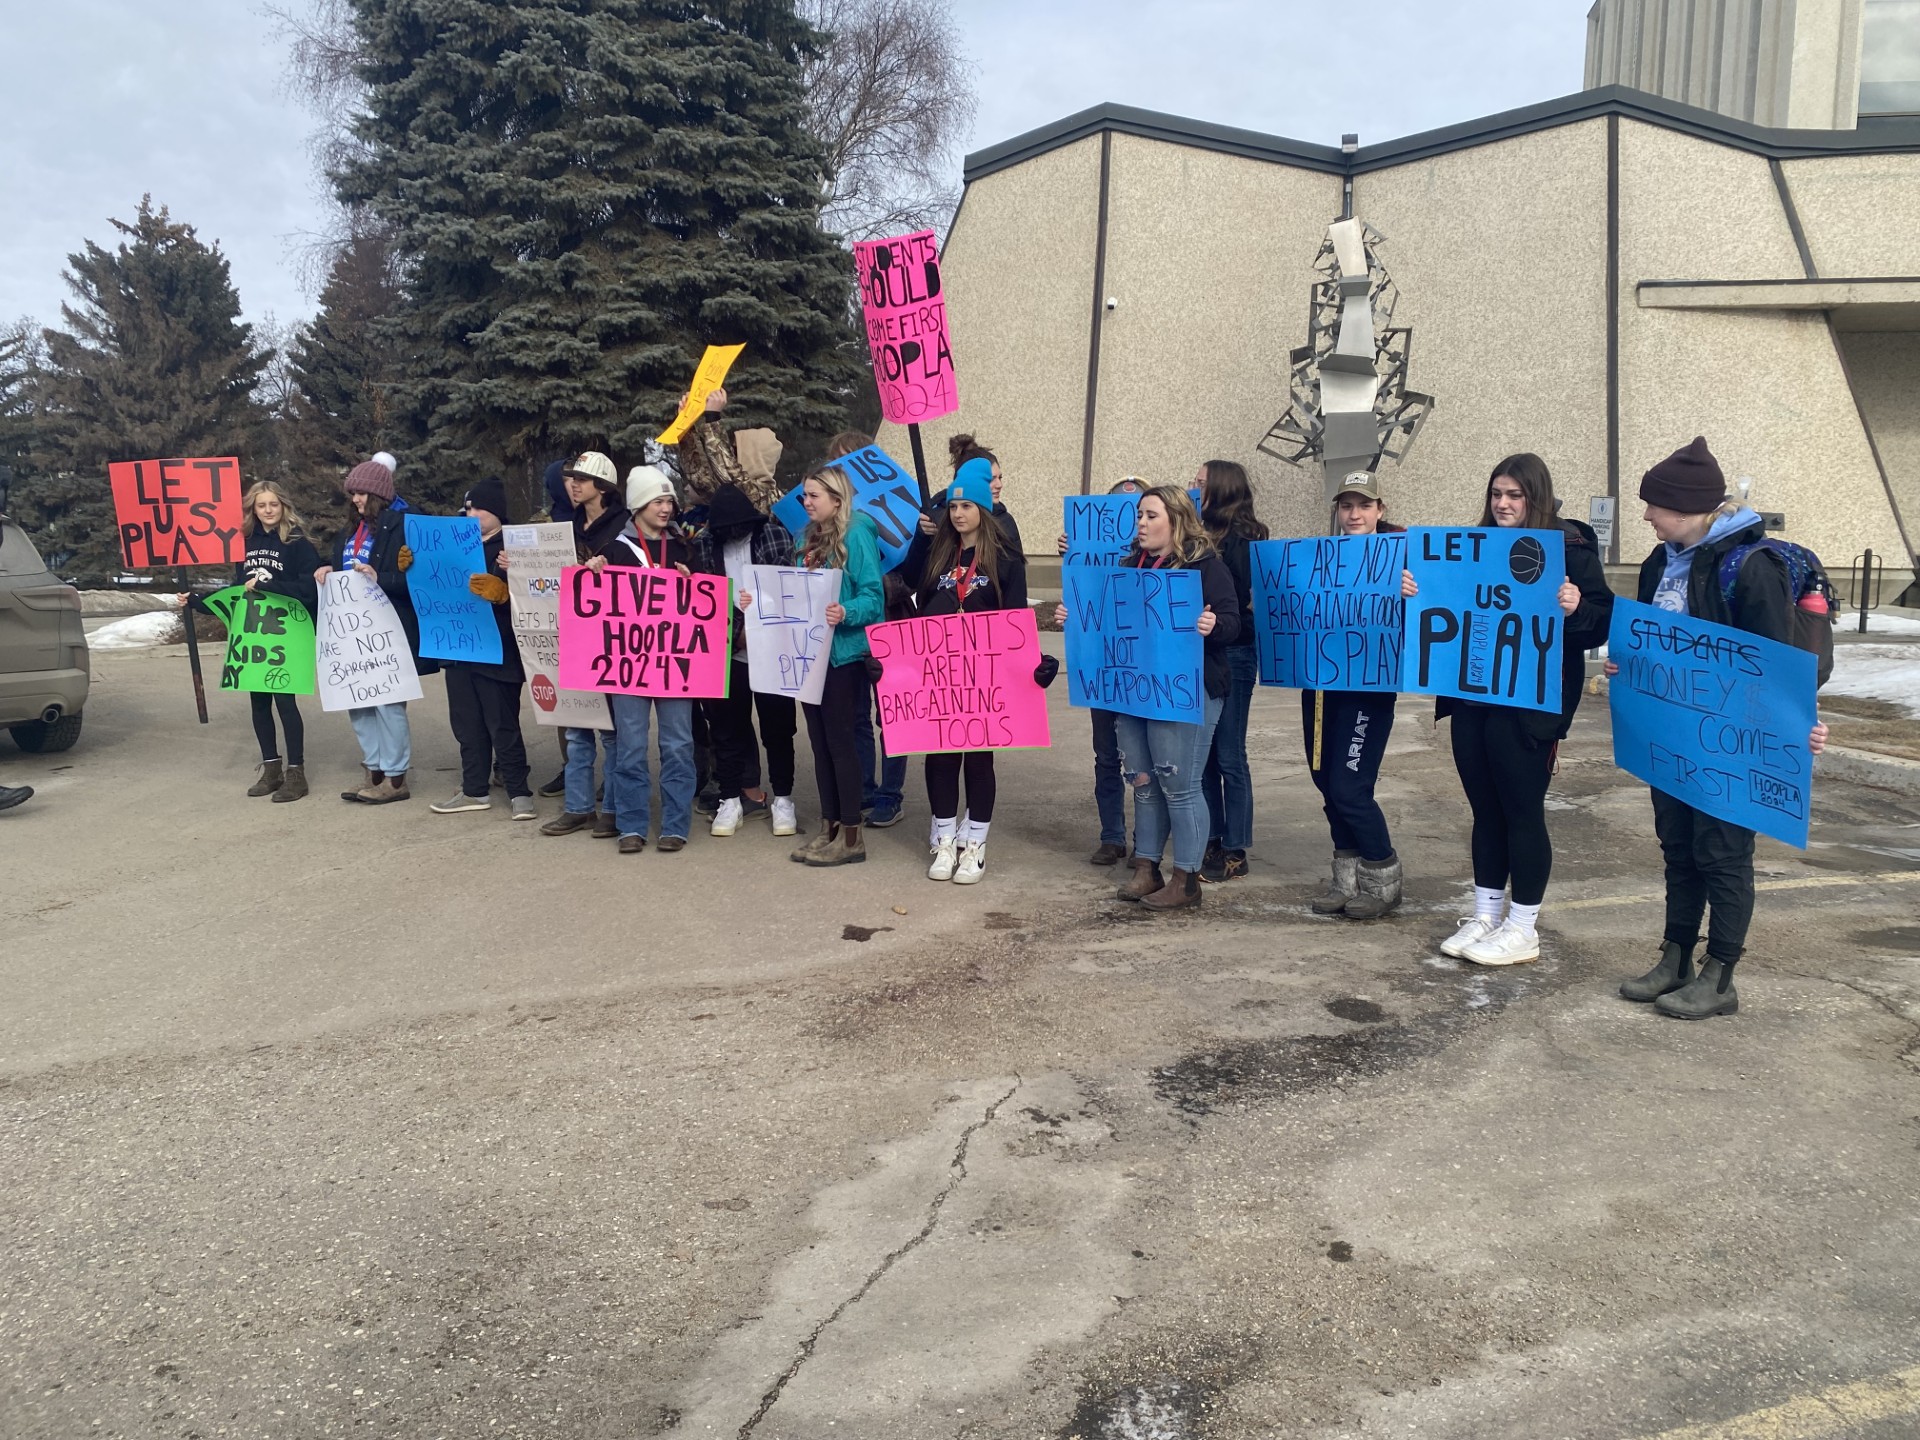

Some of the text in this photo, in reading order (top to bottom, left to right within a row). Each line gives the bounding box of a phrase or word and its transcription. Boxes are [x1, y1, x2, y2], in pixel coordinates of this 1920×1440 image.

[855, 233, 937, 271] STUDENTS
[859, 262, 941, 308] SHOULD
[868, 302, 946, 341] COME FIRST
[134, 459, 233, 505] LET
[153, 502, 218, 536] US
[407, 519, 445, 554] OUR
[540, 531, 565, 542] PLEASE
[1073, 501, 1107, 541] MY
[1103, 508, 1116, 543] 2024
[121, 522, 239, 567] PLAY
[1254, 535, 1405, 589] WE ARE NOT
[1423, 532, 1487, 563] LET
[242, 591, 289, 635] THE
[414, 588, 478, 617] DESERVE
[573, 567, 717, 621] GIVE US
[754, 570, 823, 620] LET
[1071, 571, 1198, 632] WE'RE
[1476, 583, 1512, 611] US
[325, 610, 374, 640] KIDS
[430, 625, 483, 653] PLAY!
[448, 619, 464, 632] TO
[513, 612, 541, 629] LETS
[603, 619, 710, 656] HOOPLA
[869, 610, 1026, 660] STUDENTS
[1472, 613, 1491, 661] HOOPLA
[227, 634, 286, 666] KIDS
[318, 631, 394, 663] ARE NOT
[537, 652, 559, 667] FIRS
[1104, 635, 1140, 668] NOT
[1258, 631, 1403, 687] LET US PLAY
[1419, 606, 1555, 705] PLAY
[590, 653, 691, 692] 2024!
[923, 653, 1002, 687] AREN'T
[1627, 655, 1737, 712] MONEY
[533, 686, 554, 701] STOP
[561, 699, 601, 710] AS PAWNS
[881, 686, 1006, 725] BARGAINING
[1078, 667, 1200, 713] WEAPONS!
[928, 716, 1013, 749] TOOLS
[1346, 711, 1370, 772] ARIAT
[1699, 715, 1801, 776] COMES
[1650, 741, 1744, 804] FIRST
[1753, 774, 1801, 803] HOOPLA
